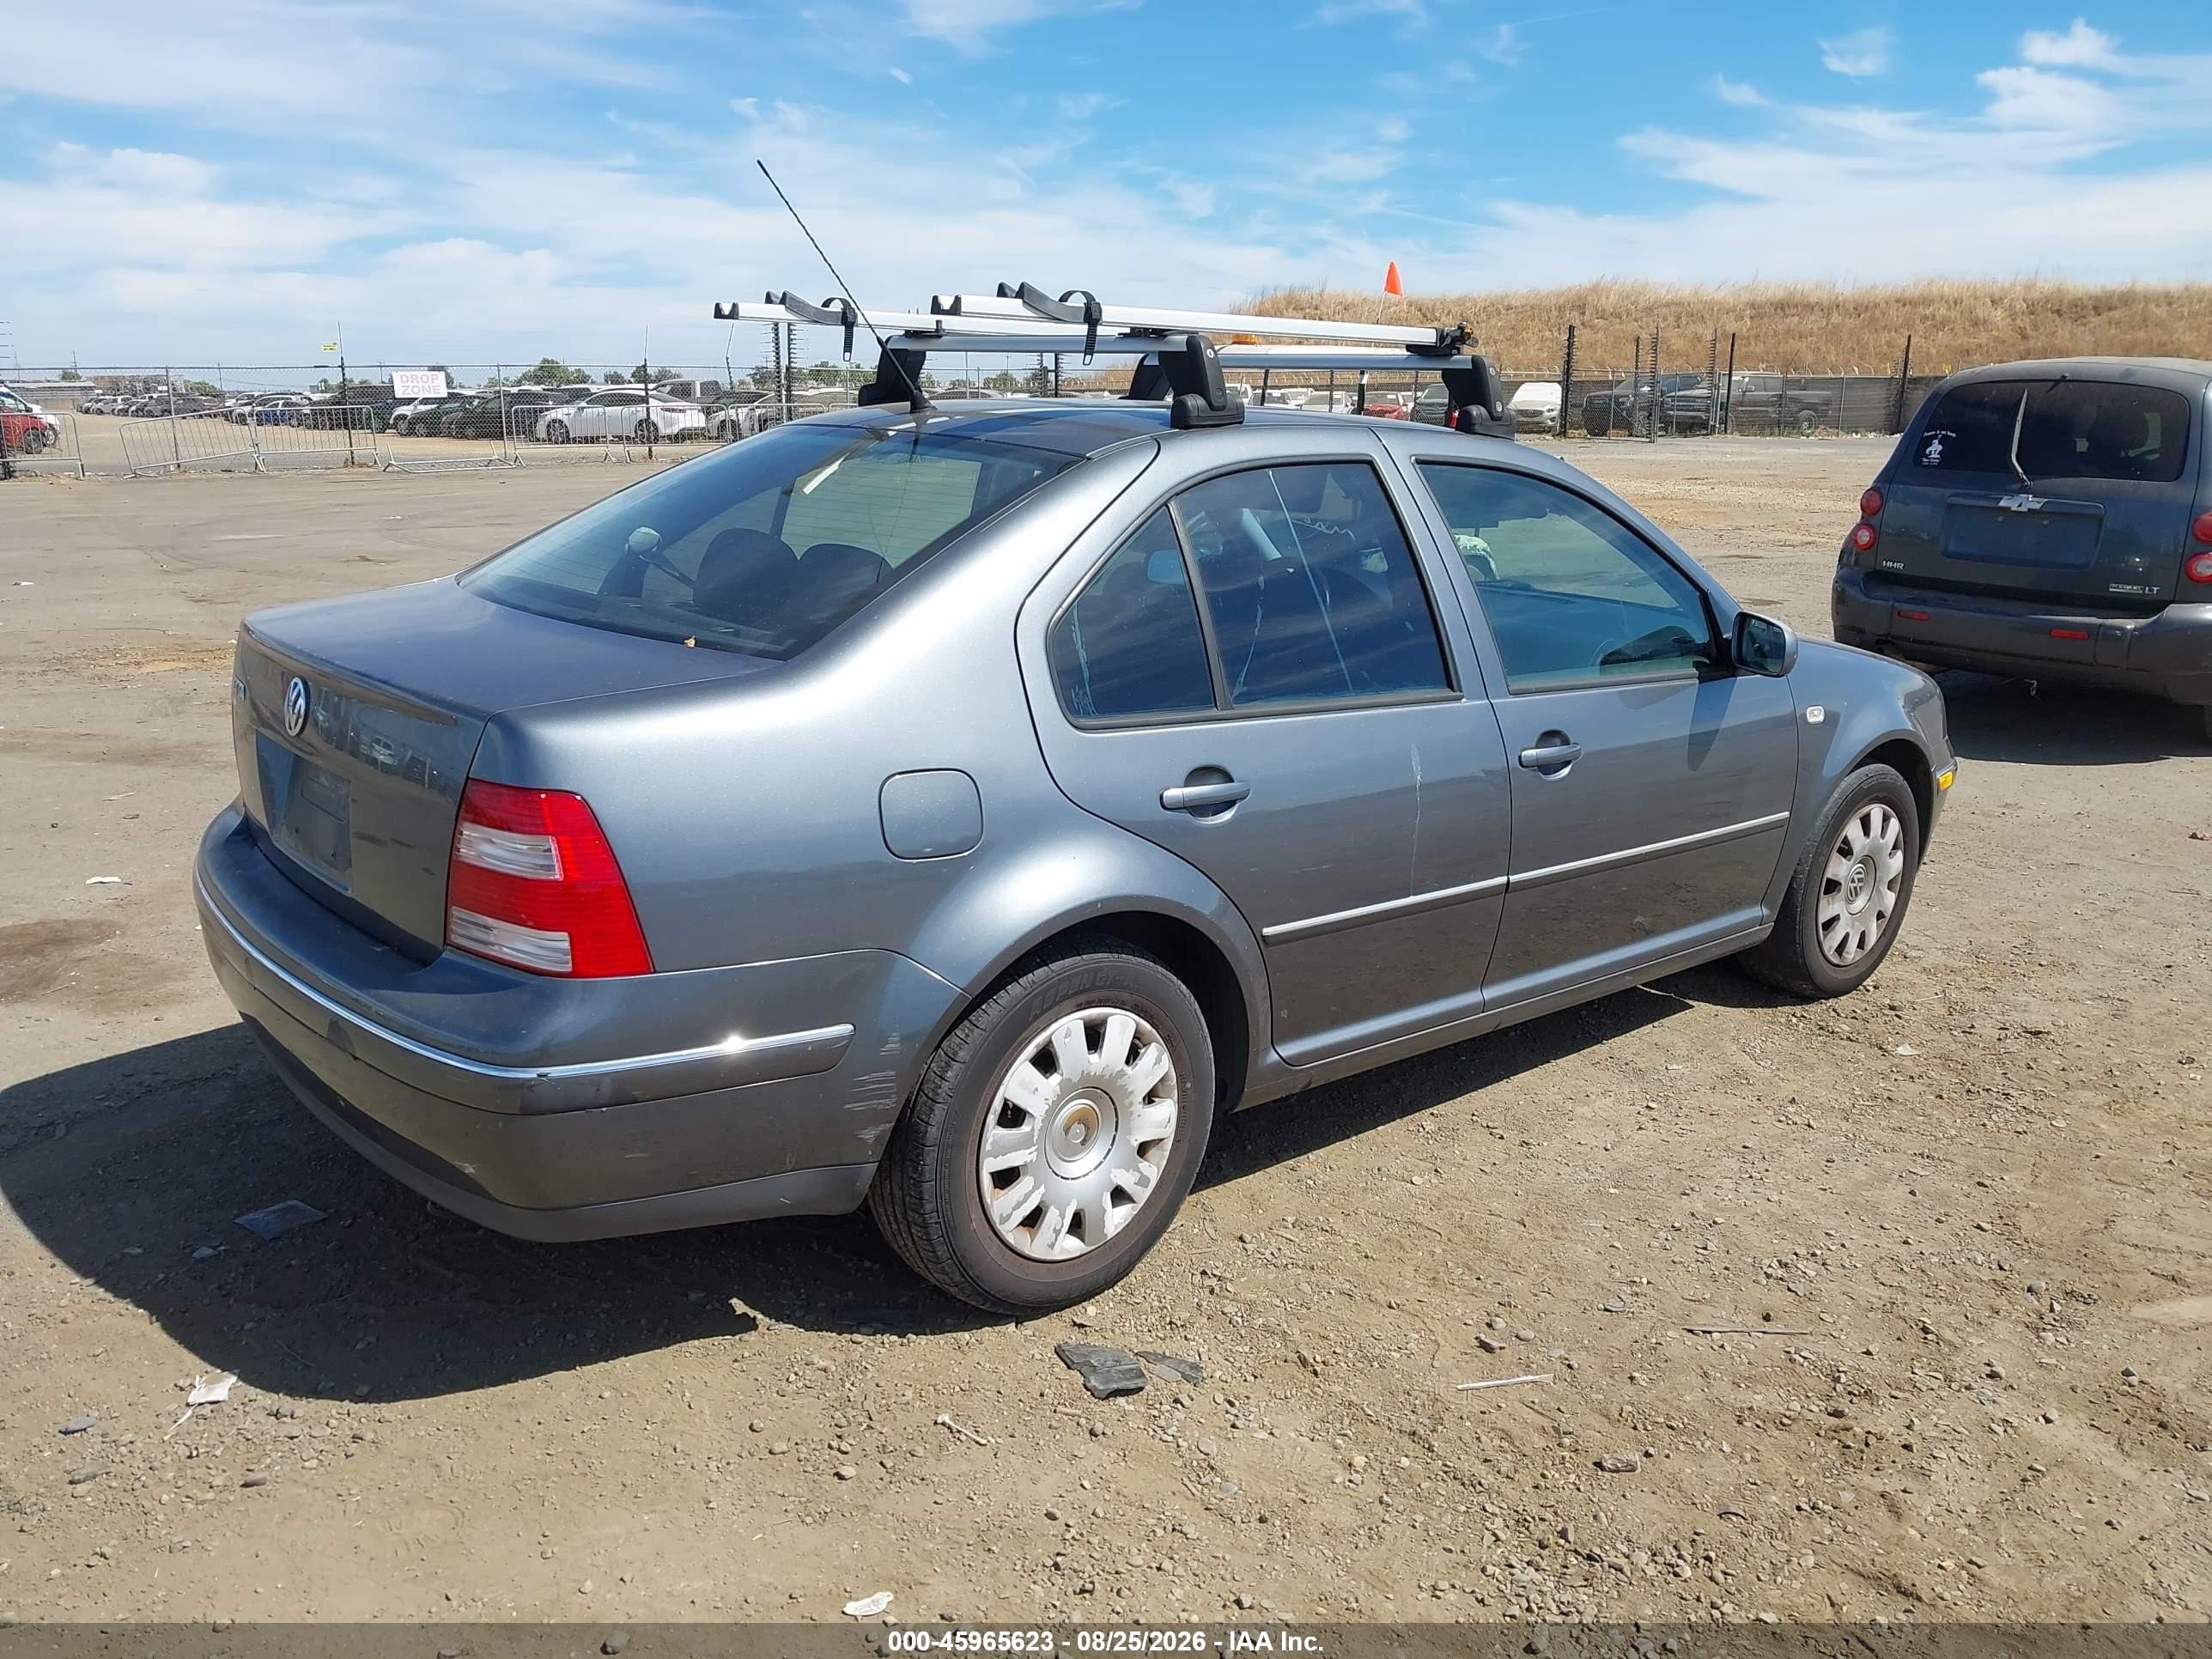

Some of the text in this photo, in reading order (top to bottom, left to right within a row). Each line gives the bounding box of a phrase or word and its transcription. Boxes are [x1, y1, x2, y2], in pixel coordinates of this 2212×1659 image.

[399, 374, 440, 385] DROP
[400, 385, 441, 395] ZONE
[1882, 560, 1905, 570] HHR
[2145, 586, 2161, 594] LT
